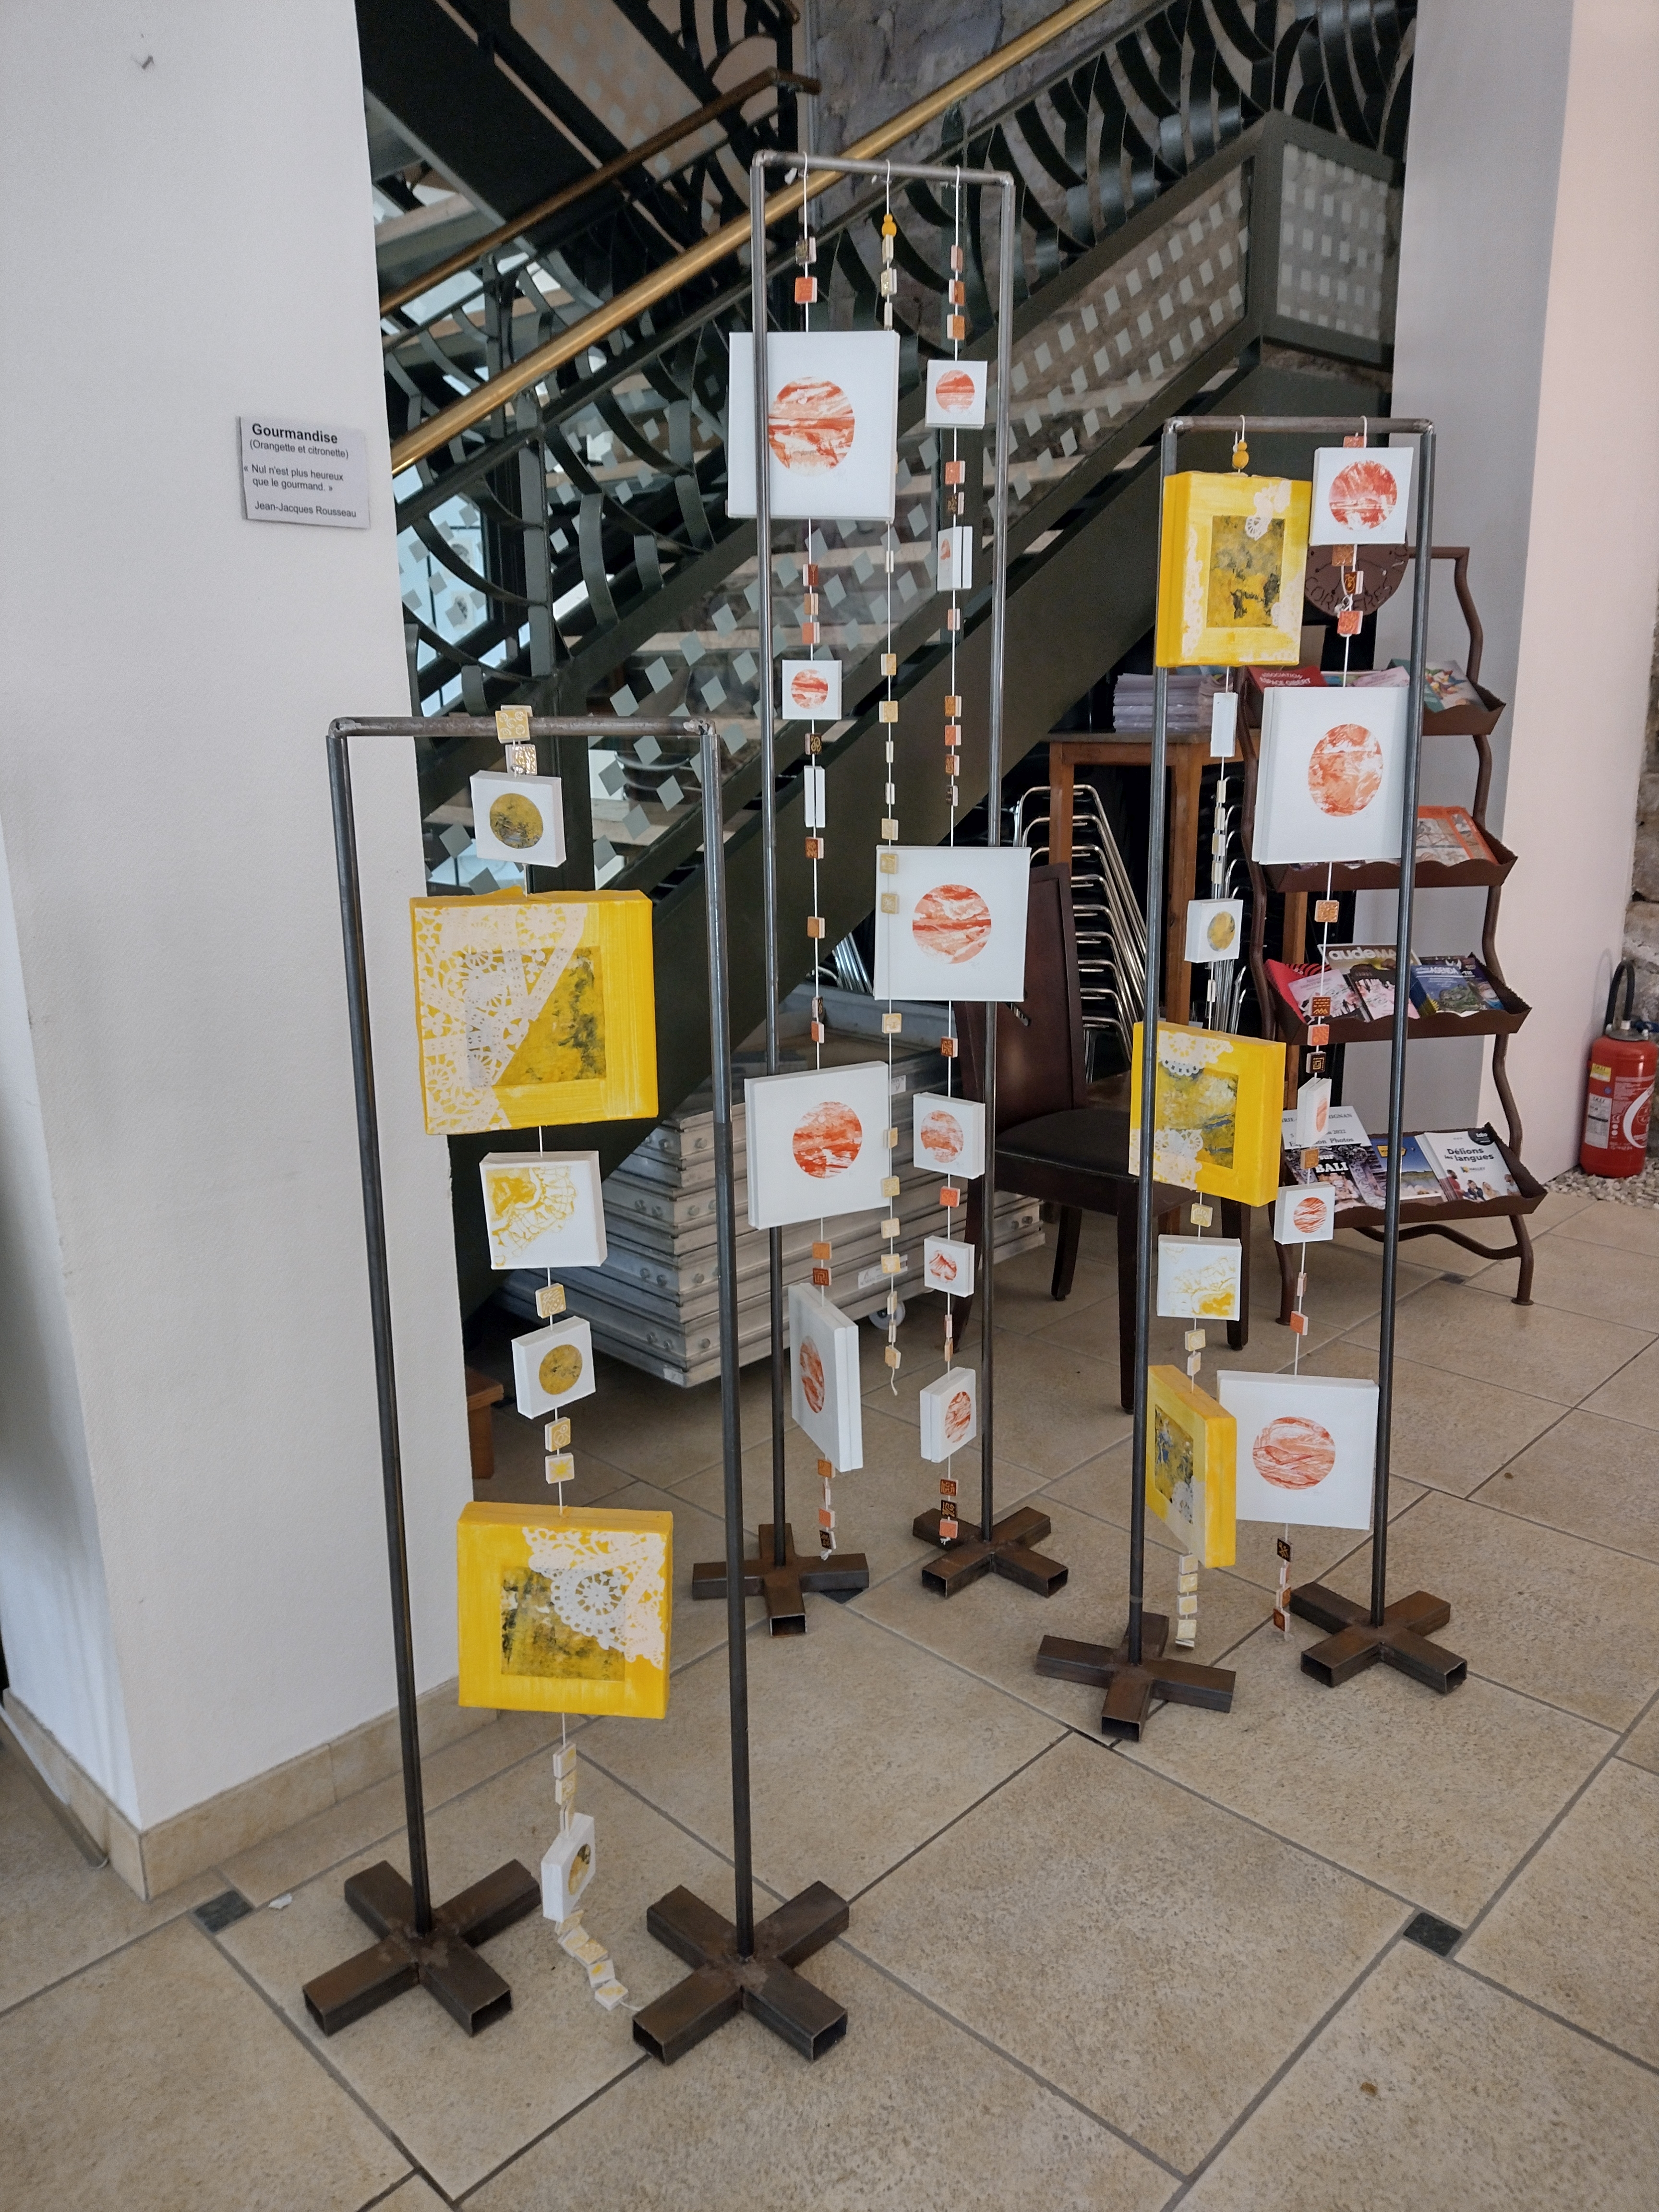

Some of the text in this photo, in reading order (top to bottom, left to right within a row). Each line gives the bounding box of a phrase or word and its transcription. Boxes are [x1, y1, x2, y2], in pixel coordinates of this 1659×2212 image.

[252, 423, 338, 444] Gourmandise
[250, 439, 349, 459] (Orangette et citronette)
[252, 464, 266, 474] Nul
[269, 466, 289, 476] n'est
[291, 469, 308, 478] plus
[311, 470, 344, 481] heureux
[252, 478, 269, 487] que
[271, 478, 279, 487] le
[281, 481, 325, 492] gourmand.
[254, 501, 357, 518] Jean-Jacques Rousseau
[1329, 946, 1397, 961] audeMA
[1455, 1154, 1494, 1163] langues
[1315, 1162, 1349, 1173] BALI
